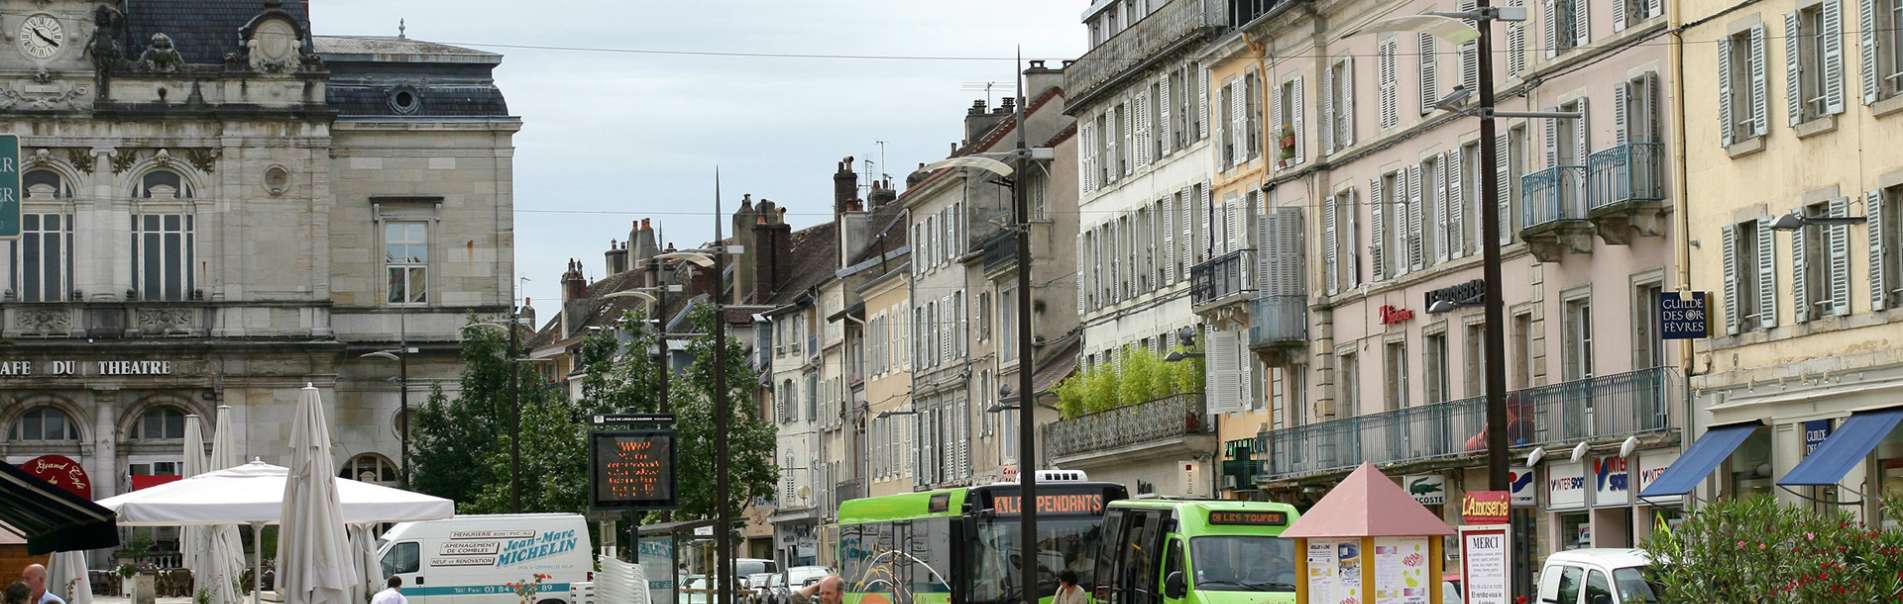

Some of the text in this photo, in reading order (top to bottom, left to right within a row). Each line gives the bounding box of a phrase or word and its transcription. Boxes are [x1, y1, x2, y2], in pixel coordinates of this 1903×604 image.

[1662, 298, 1704, 310] GUILDE
[1663, 310, 1684, 321] DES
[1664, 321, 1705, 333] FÈVRES
[52, 360, 76, 375] DU
[97, 360, 172, 375] THEATRE
[1036, 494, 1102, 512] PENDANTS
[1415, 496, 1443, 504] COSTE
[503, 529, 575, 551] Jean-Marc
[1472, 536, 1499, 549] MERCI
[496, 538, 578, 566] MICHELIN
